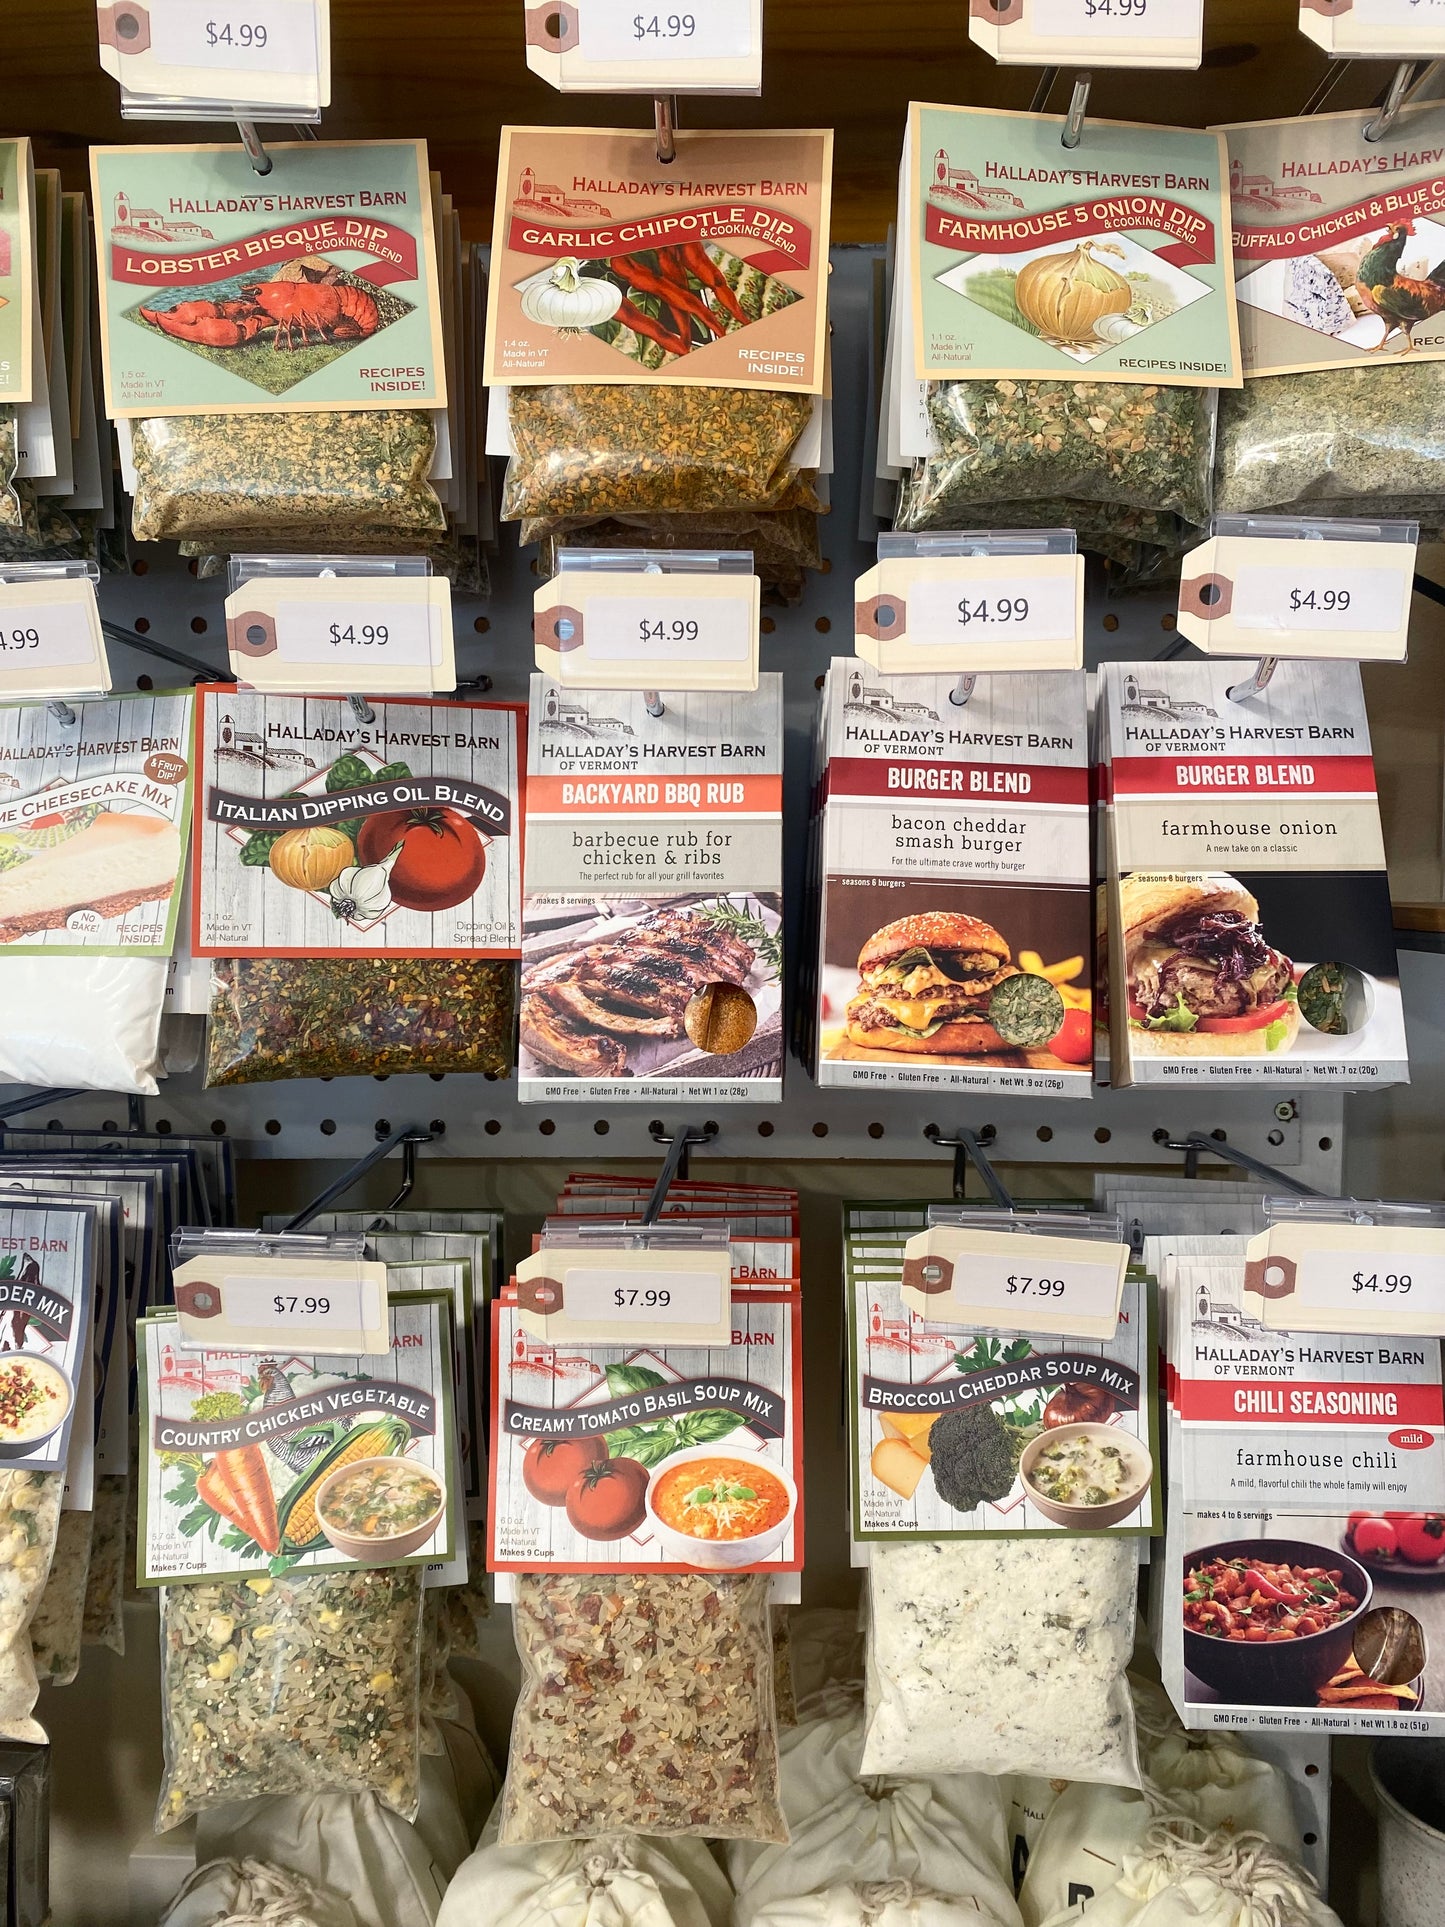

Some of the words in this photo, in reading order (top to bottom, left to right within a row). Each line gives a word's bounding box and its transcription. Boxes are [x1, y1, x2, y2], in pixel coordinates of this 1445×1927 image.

[1084, 0, 1147, 18] $4.99
[205, 20, 268, 48] $4.99
[633, 13, 696, 41] $4.99
[986, 161, 1082, 185] HALLADAY'S
[1086, 171, 1160, 188] HARVEST
[1165, 174, 1209, 190] BARN
[1282, 155, 1388, 178] HALLADAY'S
[573, 177, 674, 195] HALLADAY'S
[679, 182, 756, 196] HARVEST
[761, 180, 808, 195] BARN
[170, 197, 273, 214] HALLADAY'S
[278, 195, 354, 210] HARVEST
[359, 191, 407, 205] BARN
[938, 210, 1071, 240] FARMHOUSE
[1075, 208, 1088, 223] 5
[1092, 197, 1166, 219] ONION
[1170, 208, 1207, 233] DIP
[1232, 231, 1295, 247] BUFFALO
[1299, 209, 1366, 242] CHICKEN
[1370, 202, 1383, 217] &
[1386, 188, 1429, 212] BLUE
[522, 230, 614, 247] GARLIC
[619, 208, 745, 242] CHIPOTLE
[753, 211, 794, 235] DIP
[126, 249, 240, 274] LOBSTER
[245, 221, 337, 257] BISQUE
[345, 220, 388, 240] DIP
[305, 242, 314, 252] &
[315, 236, 365, 250] COOKING
[368, 240, 403, 264] BLEND
[738, 349, 805, 362] RECIPES
[1119, 358, 1175, 370] RECIPES
[1179, 361, 1227, 372] INSIDE!
[359, 367, 425, 378] RECIPES
[748, 362, 803, 377] INSIDE!
[371, 380, 426, 391] INSIDE!
[1290, 588, 1350, 612] $4.99
[958, 598, 1029, 626] $4.99
[330, 623, 388, 647] $4.99
[639, 619, 698, 642] $4.99
[268, 723, 370, 744] HALLADAY'S
[375, 731, 450, 747] HARVEST
[455, 734, 499, 749] BARN
[846, 726, 944, 743] HALLADAY'S
[949, 730, 1023, 746] HARVEST
[1028, 734, 1073, 749] BARN
[1126, 726, 1225, 740] HALLADAY'S
[1229, 726, 1304, 739] HARVEST
[1308, 726, 1354, 739] BARN
[77, 740, 138, 757] HARVEST
[142, 737, 178, 752] BARN
[542, 744, 638, 758] HALLADAY'S
[643, 744, 716, 757] HARVEST
[721, 744, 766, 757] BARN
[151, 759, 157, 768] &
[158, 760, 183, 773] FRUIT
[157, 769, 176, 781] DIP!
[560, 761, 575, 770] OF
[579, 761, 638, 770] VERMONT
[1176, 765, 1250, 785] BURGER
[1256, 765, 1315, 785] BLEND
[888, 768, 963, 791] BURGER
[970, 771, 1031, 794] BLEND
[21, 780, 138, 817] CHEESECAKE
[141, 787, 173, 809] MIX
[216, 800, 297, 821] ITALIAN
[302, 788, 389, 820] DIPPING
[393, 786, 430, 803] OIL
[434, 785, 505, 823] BLEND
[562, 784, 659, 804] BACKYARD
[664, 784, 701, 807] BBQ
[707, 783, 744, 803] RUB
[892, 814, 946, 831] bacon
[953, 817, 1026, 834] cheddar
[1162, 820, 1271, 836] farmhouse
[1280, 820, 1337, 835] onion
[572, 832, 660, 847] barbecue
[666, 832, 698, 846] rub
[706, 831, 732, 846] for
[896, 835, 954, 850] smash
[962, 836, 1022, 854] burger
[583, 850, 656, 865] chicken
[664, 851, 677, 865] &
[684, 850, 721, 865] ribs
[579, 872, 592, 880] The
[594, 872, 618, 882] perfect
[621, 872, 633, 880] rub
[636, 872, 645, 880] for
[648, 872, 656, 880] all
[659, 874, 674, 882] your
[676, 872, 690, 882] grill
[692, 872, 724, 880] favorites
[71, 921, 99, 932] BAKE!
[81, 913, 95, 923] NO
[457, 922, 491, 932] Dipping
[495, 921, 506, 930] Oil
[116, 924, 163, 933] RECIPES
[121, 934, 161, 943] INSIDE!
[454, 934, 486, 945] Spread
[489, 934, 516, 943] Blend
[590, 1087, 612, 1095] Gluten
[730, 1087, 748, 1096] (28g)
[30, 1237, 67, 1252] BARN
[1006, 1275, 1065, 1297] $7.99
[1352, 1271, 1412, 1294] $4.99
[274, 1295, 330, 1314] $7.99
[614, 1288, 670, 1307] $7.99
[37, 1296, 69, 1324] MIX
[731, 1331, 775, 1345] BARN
[1196, 1346, 1294, 1362] HALLADAY'S
[1299, 1348, 1374, 1363] HARVEST
[1379, 1350, 1424, 1364] BARN
[1214, 1366, 1230, 1374] OF
[1235, 1366, 1294, 1375] VERMONT
[869, 1387, 955, 1406] BROCCOLI
[959, 1367, 1042, 1399] CHEDDAR
[1046, 1361, 1097, 1377] SOUP
[1100, 1369, 1133, 1394] MIX
[510, 1413, 574, 1432] CREAMY
[578, 1402, 640, 1429] TOMATO
[644, 1391, 691, 1411] BASIL
[694, 1385, 741, 1401] SOUP
[743, 1392, 773, 1417] MIX
[1234, 1390, 1284, 1412] CHILI
[1290, 1391, 1397, 1416] SEASONING
[161, 1426, 241, 1447] COUNTRY
[246, 1402, 324, 1437] CHICKEN
[327, 1390, 430, 1419] VEGETABLE
[1400, 1434, 1423, 1443] mild
[1237, 1449, 1343, 1468] farmhouse
[1352, 1452, 1397, 1469] chili
[898, 1520, 918, 1528] Cups
[534, 1549, 554, 1558] Cups
[151, 1564, 176, 1572] Makes
[186, 1562, 207, 1572] Cups
